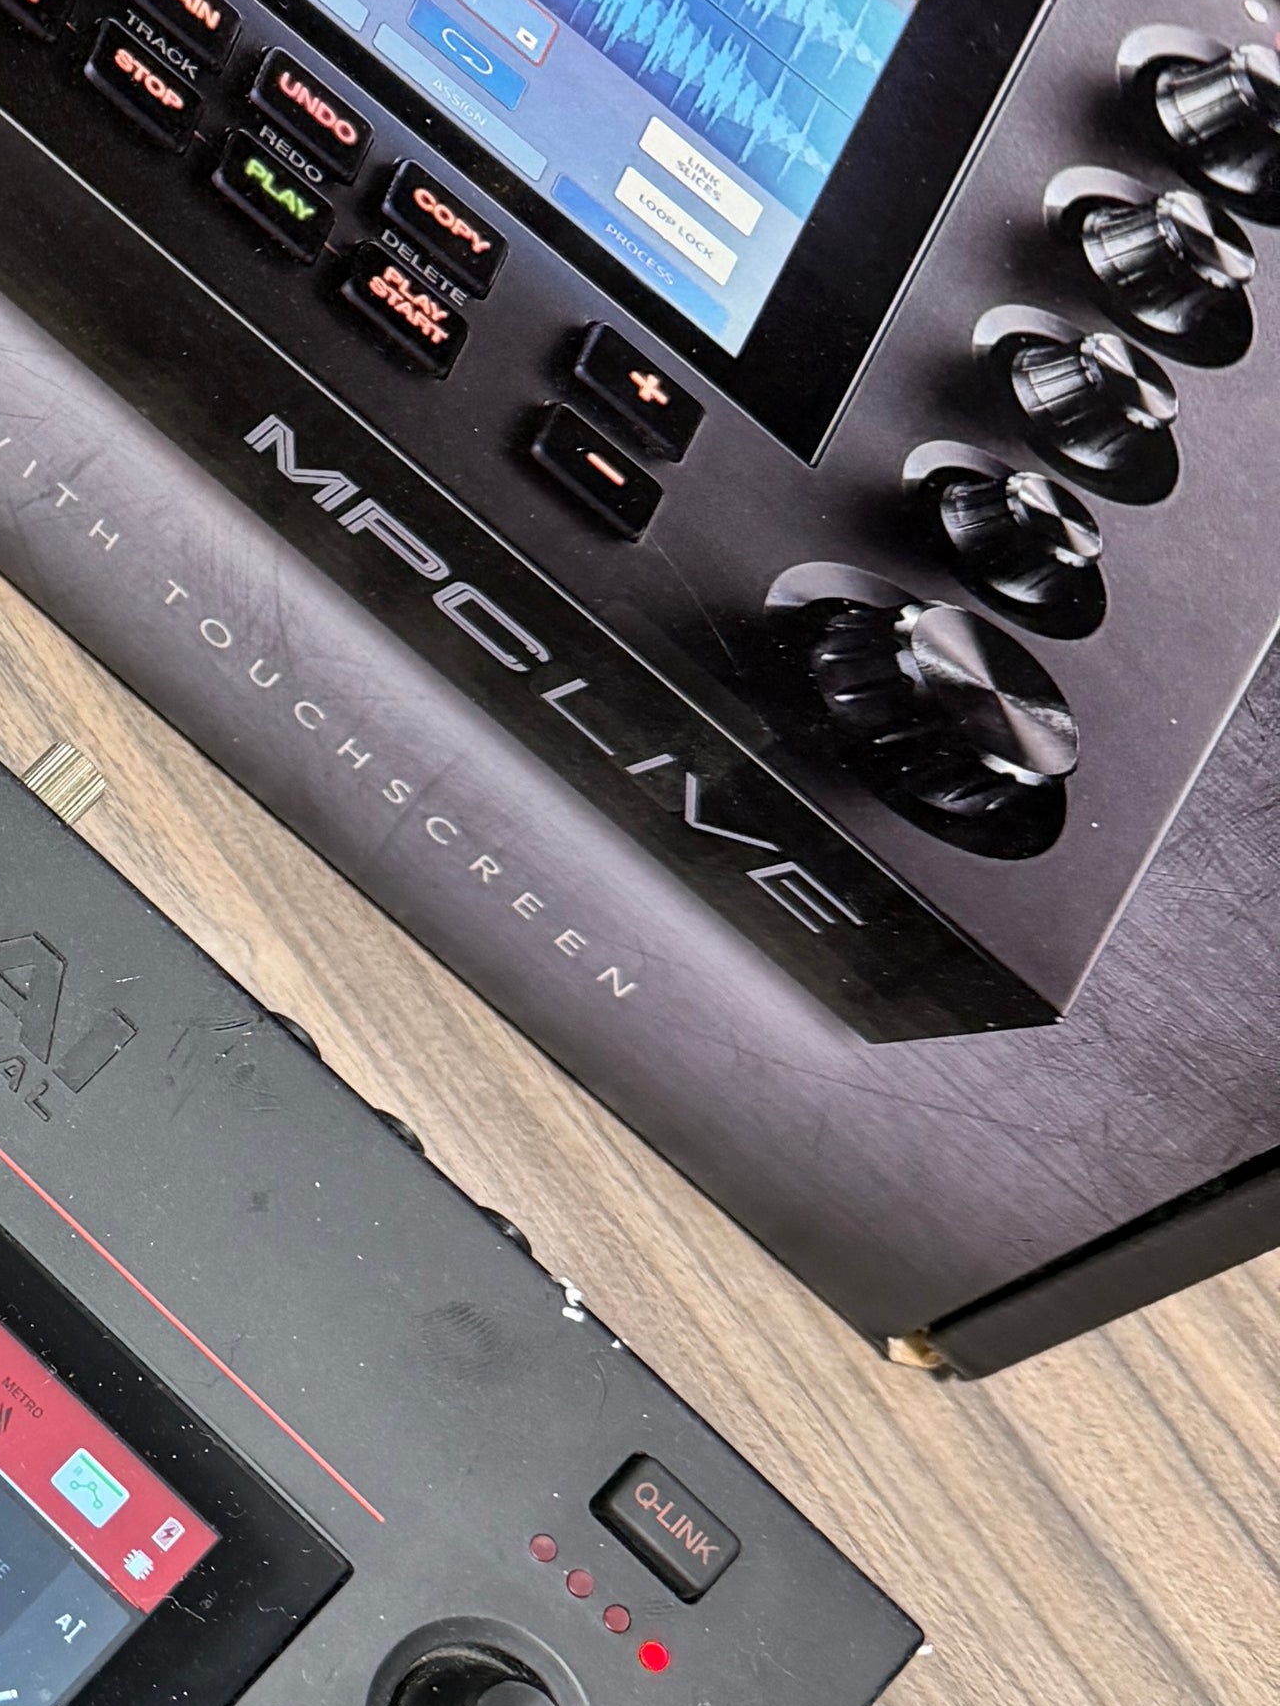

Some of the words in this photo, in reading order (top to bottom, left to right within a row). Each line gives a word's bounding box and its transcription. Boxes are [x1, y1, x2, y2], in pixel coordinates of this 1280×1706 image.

[125, 9, 200, 80] TRACK
[114, 47, 185, 112] STOP
[280, 70, 358, 147] UNDO
[432, 78, 487, 128] ASSIGN
[258, 124, 325, 185] REDO
[244, 160, 317, 222] PLAY
[412, 187, 492, 255] COPY
[604, 223, 676, 286] PROCESS
[638, 193, 676, 226] LOOP
[677, 224, 714, 261] LOCK
[381, 227, 470, 307] DELETE
[368, 277, 450, 345] START
[162, 579, 636, 999] TOUCHSCREEN
[0, 1376, 44, 1420] METRO
[633, 1481, 721, 1566] Q-LINK
